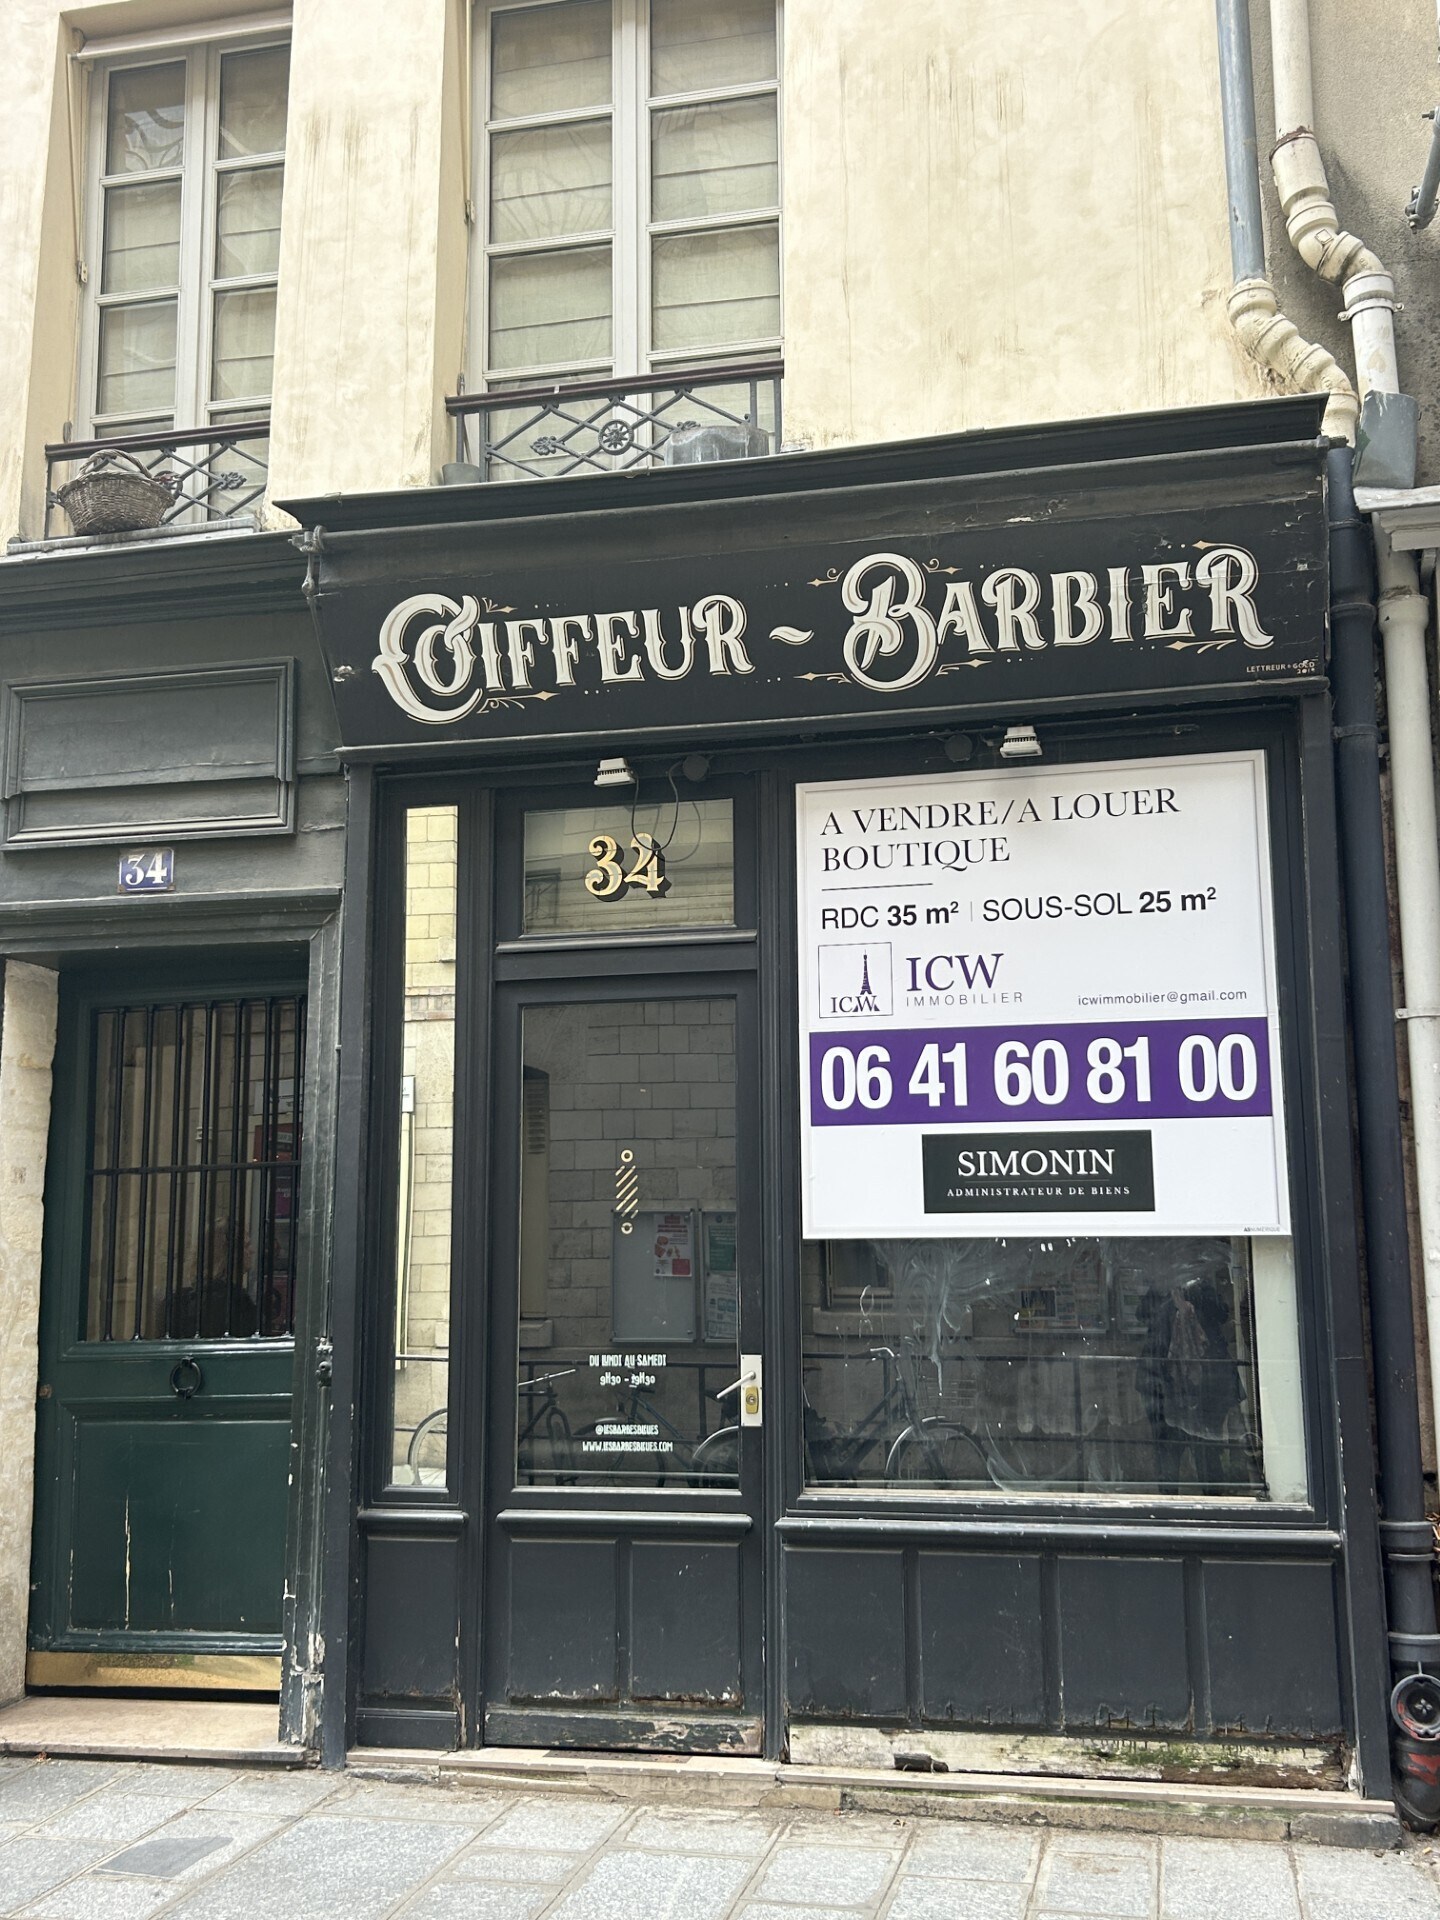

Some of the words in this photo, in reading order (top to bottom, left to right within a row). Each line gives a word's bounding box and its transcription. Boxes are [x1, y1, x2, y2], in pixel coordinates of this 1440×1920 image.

[371, 593, 756, 724] COIFFEUR
[841, 547, 1275, 692] BARBIER
[1246, 663, 1286, 673] LETTREUR
[820, 811, 844, 836] A
[1051, 787, 1182, 821] LOUER
[125, 852, 168, 886] 34
[585, 832, 667, 898] 34
[821, 836, 1010, 872] BOUTIQUE
[821, 905, 879, 930] RDC
[887, 904, 918, 926] 35
[983, 892, 1132, 922] SOUS-SOL
[1139, 890, 1172, 913] 25
[906, 953, 1004, 992] ICW
[831, 995, 880, 1013] ICW
[906, 991, 1023, 1008] IMMOBILIER
[1078, 989, 1248, 1005] icwimmobilier@gmail.com
[820, 1044, 893, 1110] 06
[908, 1042, 968, 1107] 41
[993, 1039, 1069, 1106] 60
[1086, 1036, 1151, 1104] 81
[1178, 1033, 1258, 1102] 00
[957, 1149, 1116, 1176] SIMONIN
[947, 1187, 1063, 1197] ADMINISTRATEUR
[1069, 1187, 1085, 1195] DE
[1091, 1186, 1130, 1196] BIENS
[589, 1354, 600, 1366] DU
[601, 1354, 622, 1366] LUNDI
[624, 1354, 635, 1367] AU
[637, 1354, 667, 1366] SAMEDI
[600, 1371, 621, 1386] 9H30
